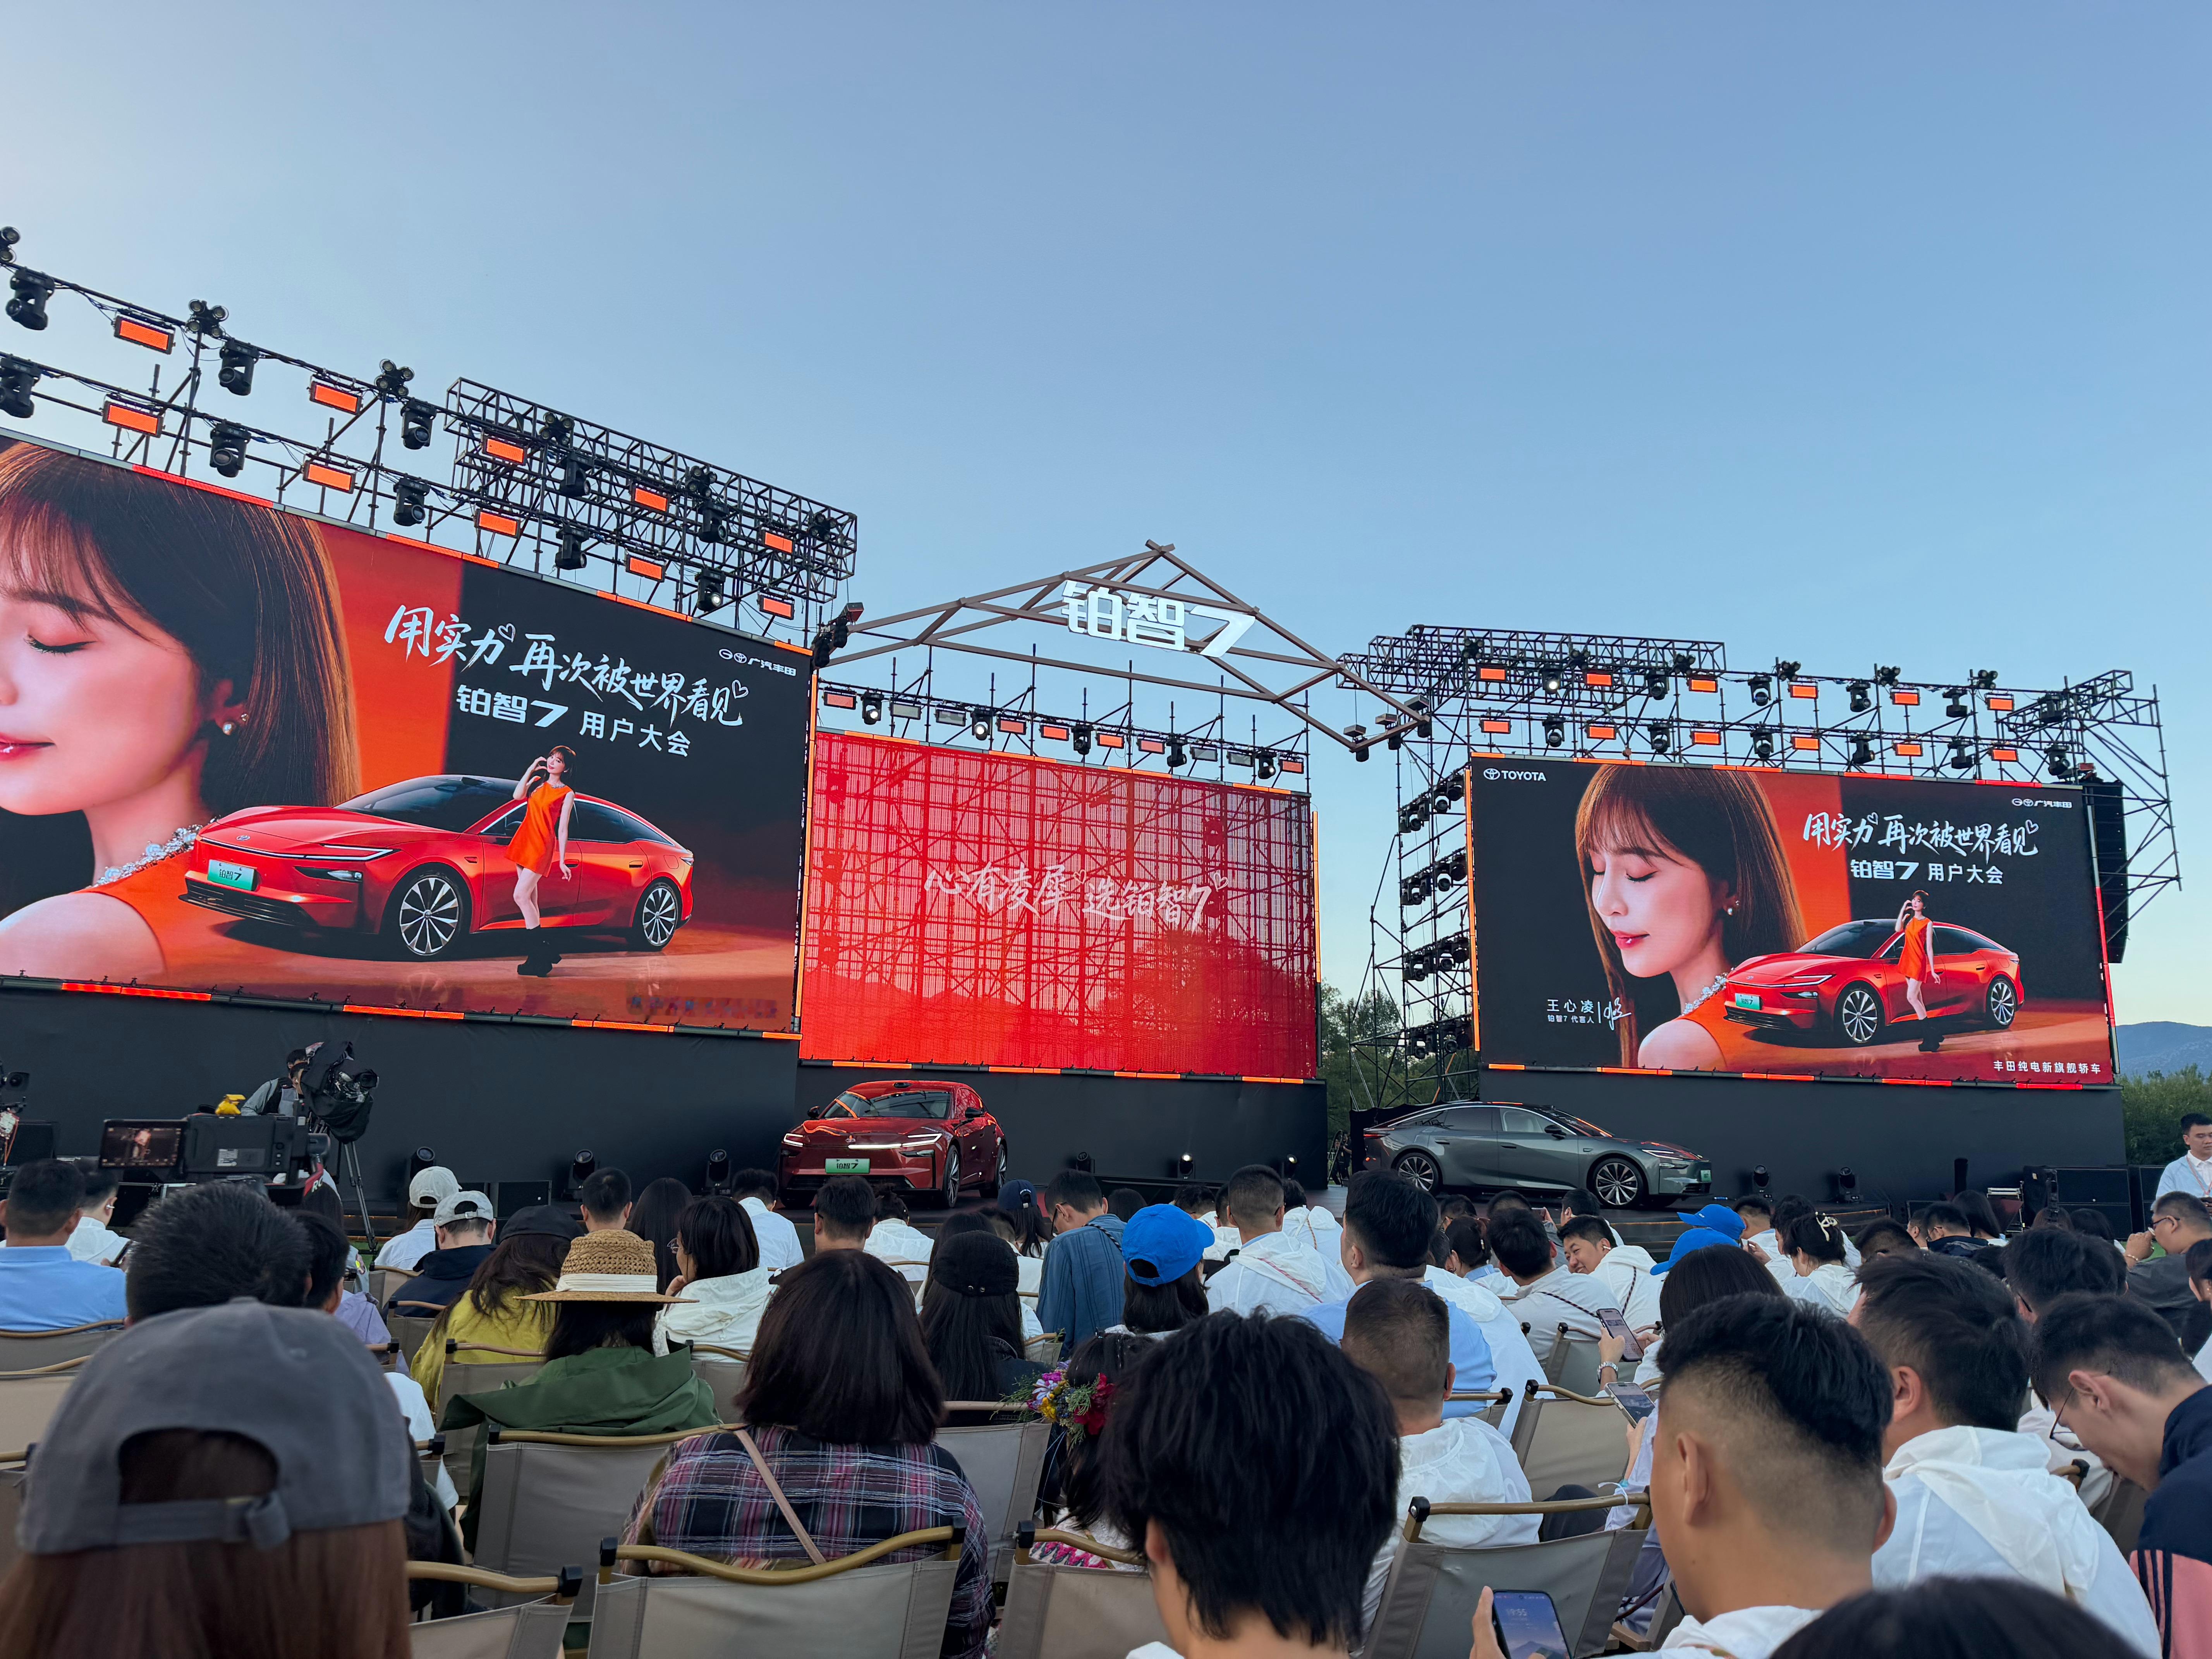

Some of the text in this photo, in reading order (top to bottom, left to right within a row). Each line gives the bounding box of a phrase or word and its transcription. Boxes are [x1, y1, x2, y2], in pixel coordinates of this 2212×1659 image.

[1061, 580, 1256, 658] 铂智7
[385, 604, 743, 727] 用实力 再次被世界看见
[748, 658, 796, 676] 广汽丰田
[456, 684, 691, 757] 铂智7 用户大会
[1501, 770, 1546, 781] TOYOTA
[1803, 812, 2038, 864] 用实力 再次被世界看见
[1850, 860, 2003, 884] 铂智7 用户大会
[1547, 999, 1594, 1013] 王心凌
[1993, 1060, 2101, 1074] 丰田纯电新旗舰轿车
